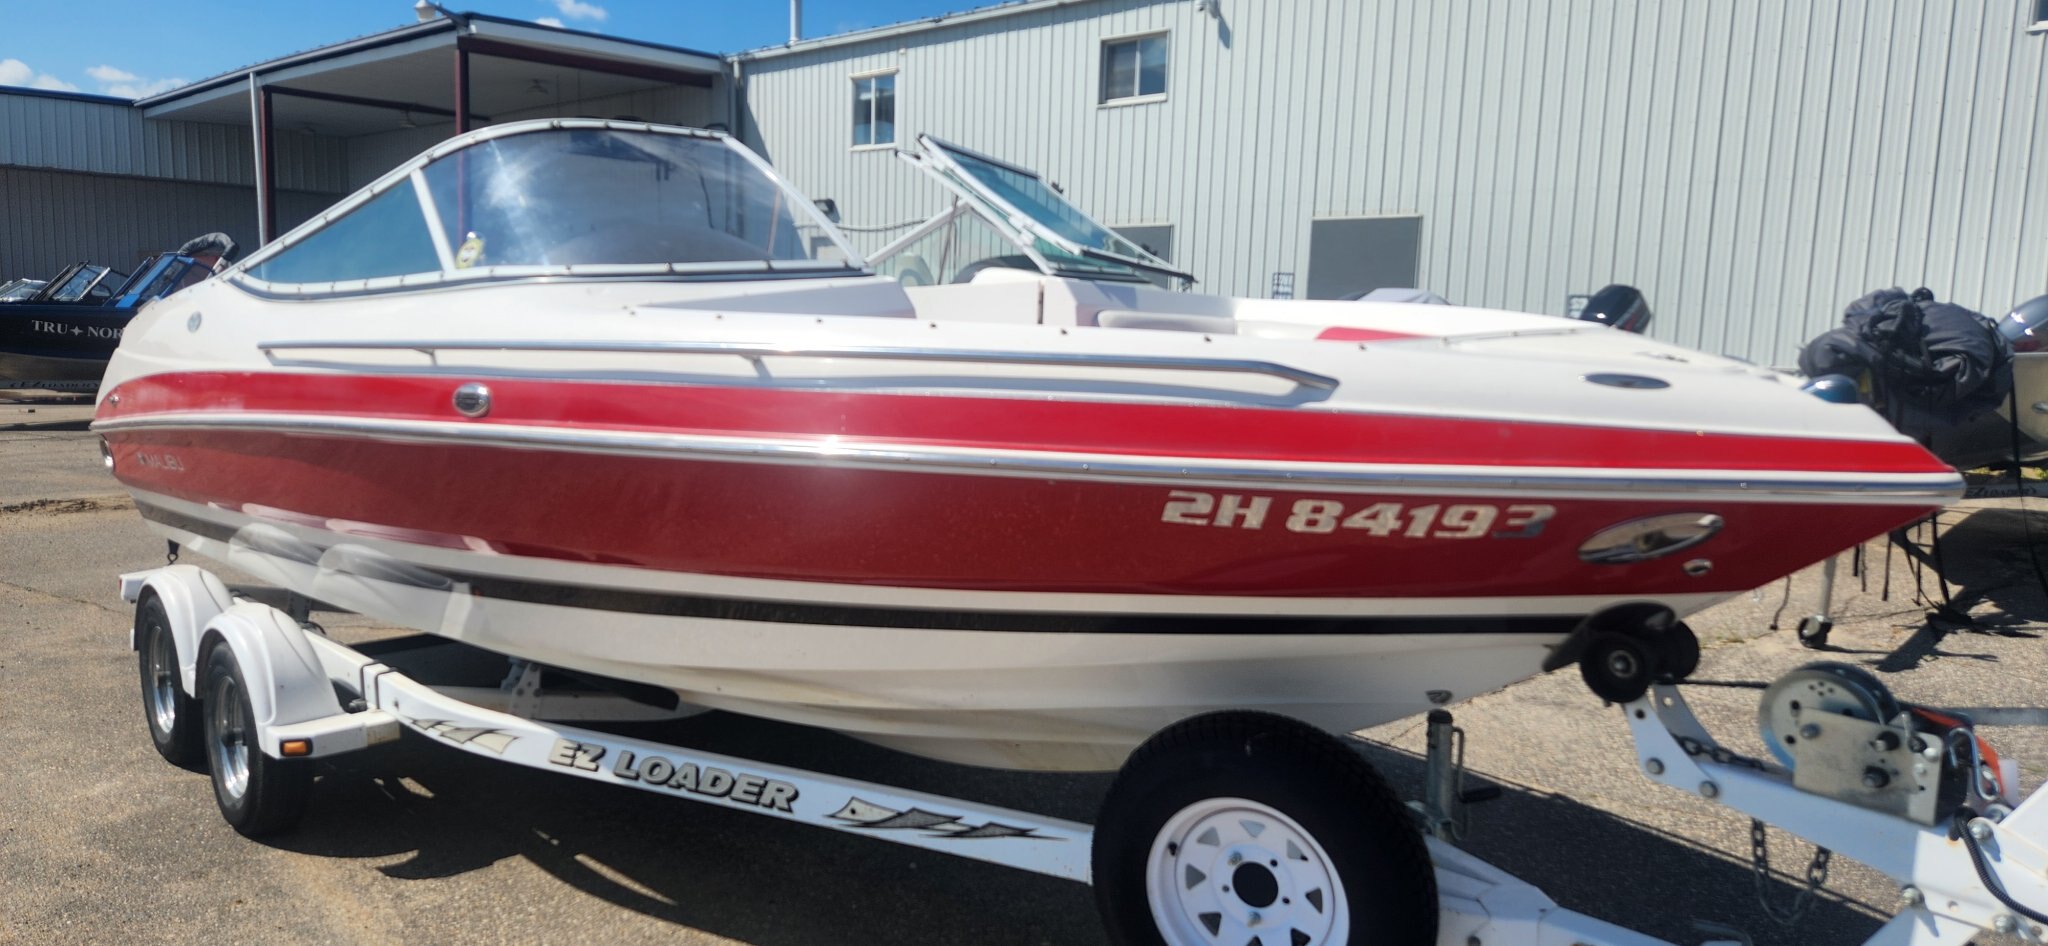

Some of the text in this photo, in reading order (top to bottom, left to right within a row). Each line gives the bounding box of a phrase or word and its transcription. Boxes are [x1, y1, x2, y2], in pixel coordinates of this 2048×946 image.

[31, 319, 68, 335] TRU
[1161, 489, 1557, 540] 2H 84193
[548, 738, 799, 813] EZ LOADER
